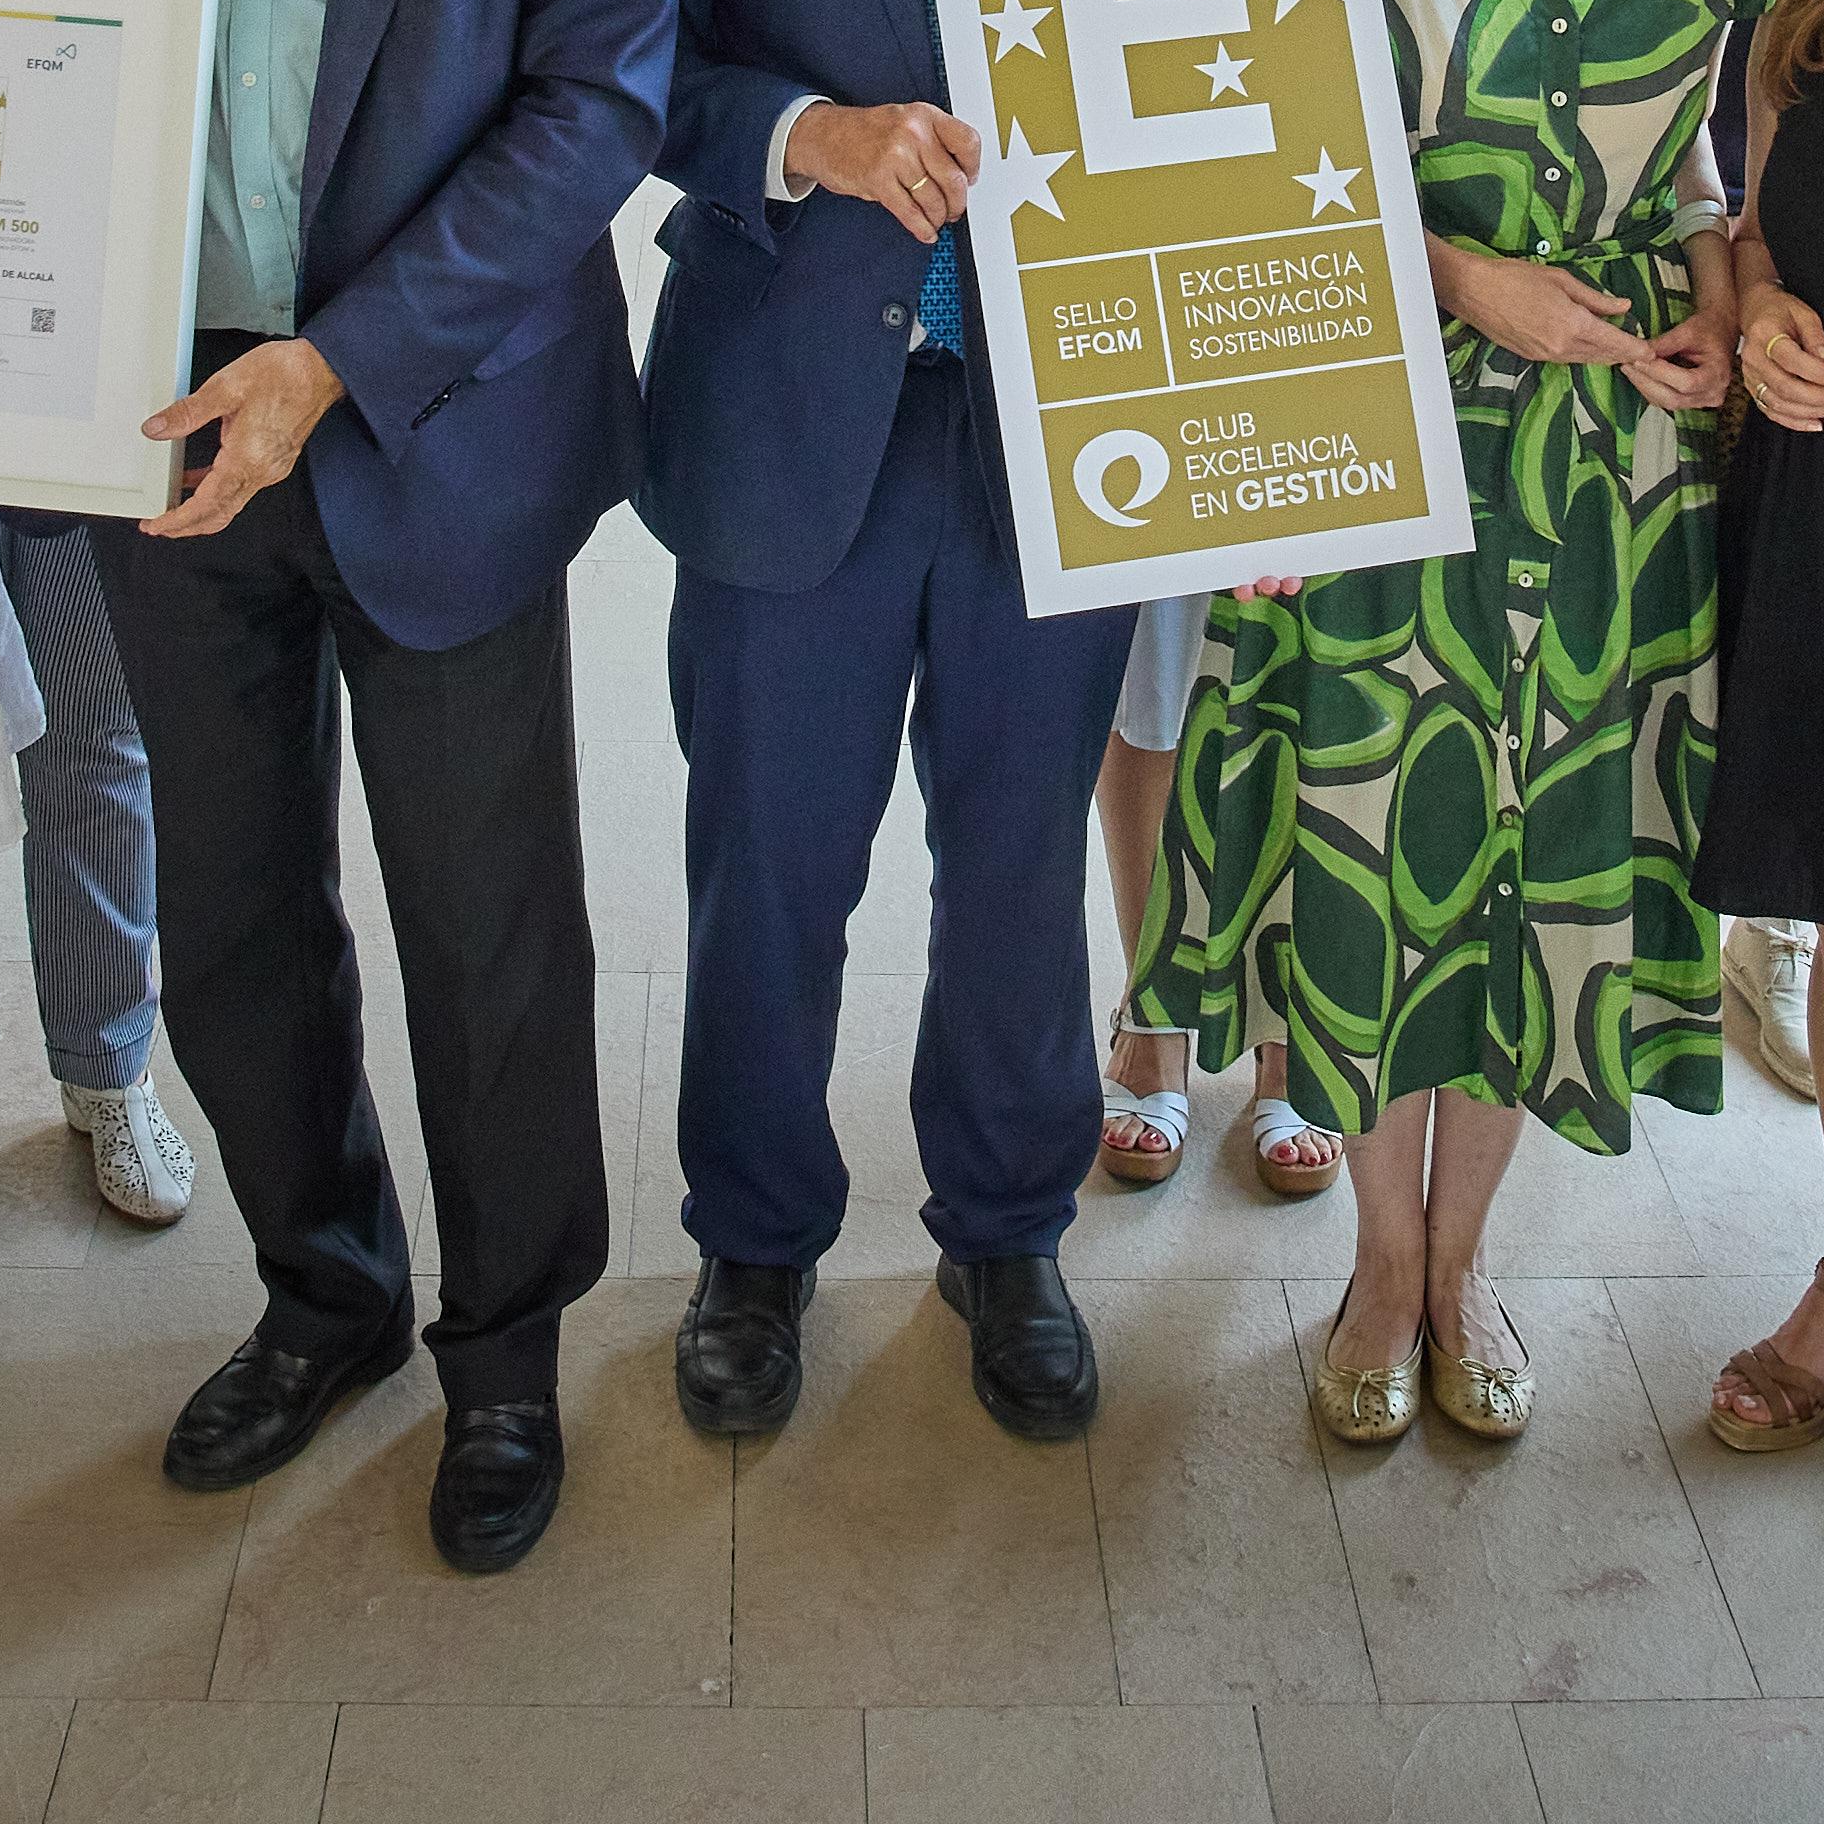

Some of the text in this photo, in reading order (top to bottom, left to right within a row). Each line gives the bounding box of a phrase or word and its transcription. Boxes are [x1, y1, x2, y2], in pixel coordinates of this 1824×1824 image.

[26, 58, 63, 72] EFQM
[11, 219, 40, 235] 500
[2, 269, 15, 279] DE
[1178, 250, 1364, 298] EXCELENCIA
[1053, 297, 1138, 330] SELLO
[1183, 280, 1369, 329] INNOVACIÓN
[1057, 326, 1144, 361] EFQM
[1189, 315, 1373, 361] SOSTENIBILIDAD
[1179, 411, 1257, 447] CLUB
[1185, 432, 1360, 481] EXCELENCIA
[1191, 457, 1397, 520] EN GESTIÓN
